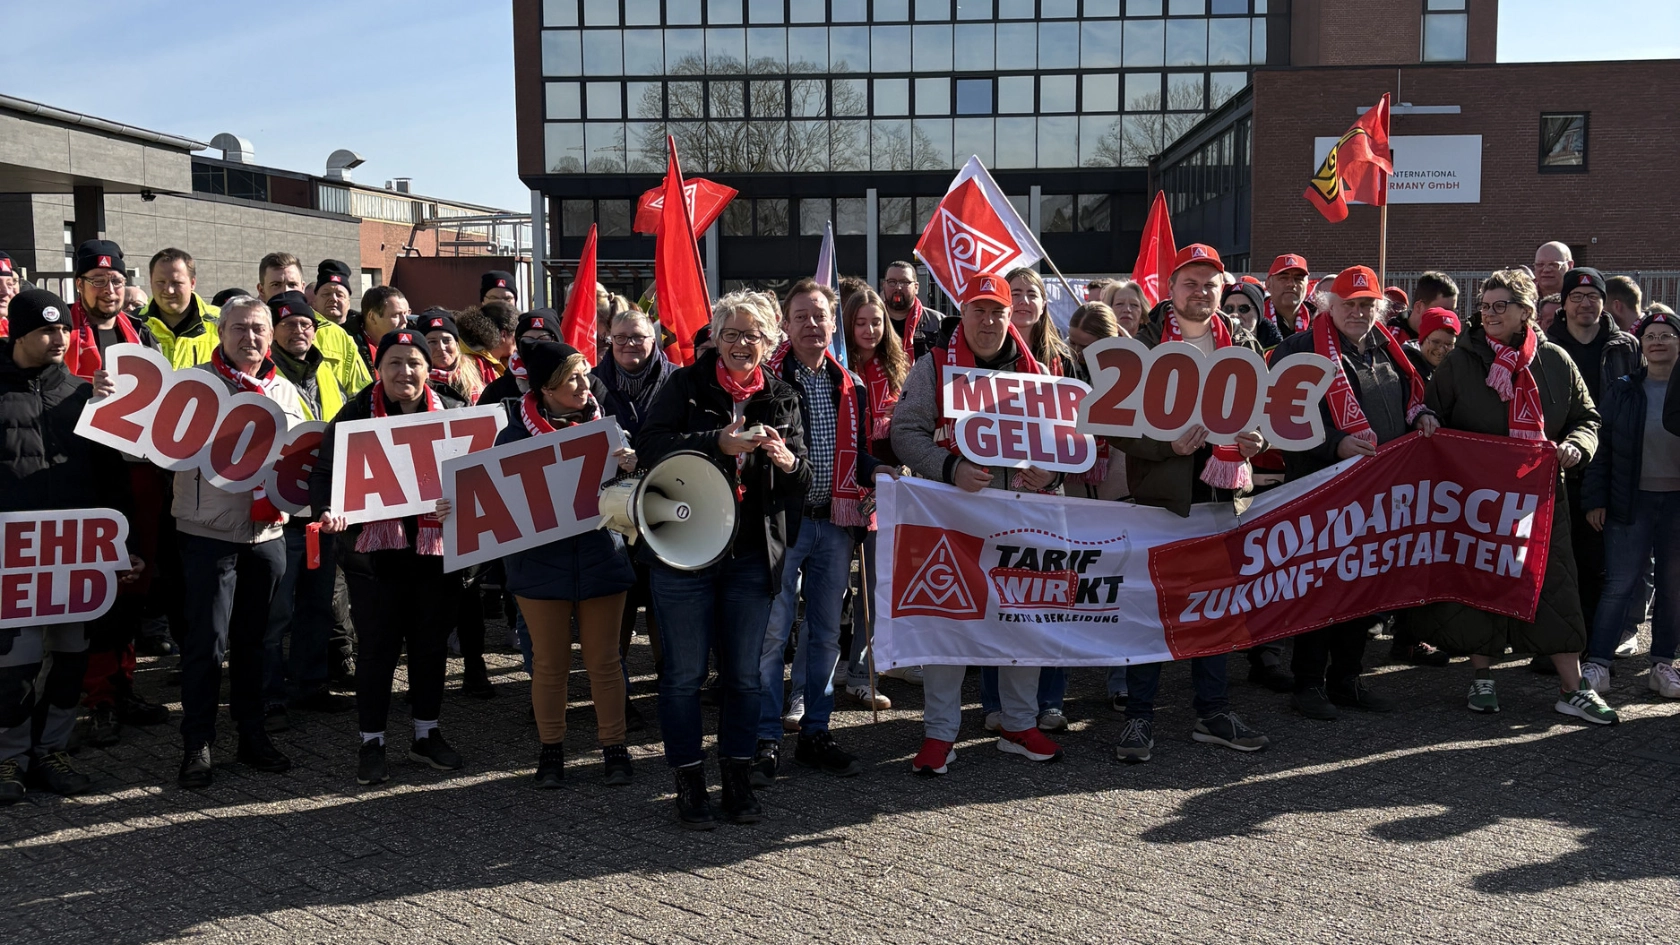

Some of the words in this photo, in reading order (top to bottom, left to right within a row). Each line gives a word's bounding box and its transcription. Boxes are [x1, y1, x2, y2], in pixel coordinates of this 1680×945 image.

[1389, 182, 1426, 190] RMANY
[1428, 181, 1460, 190] GmbH
[1391, 170, 1457, 178] NTERNATIONAL
[952, 373, 1088, 421] MEHR
[1088, 347, 1326, 441] 200€
[964, 416, 1088, 465] GELD
[455, 431, 610, 556] ATZ
[0, 518, 118, 568] EHR
[1238, 479, 1540, 576] SOLIDARISCH
[995, 545, 1102, 574] TARIF
[1179, 556, 1338, 623] ZUKUNFT
[1337, 530, 1529, 582] GESTALTEN
[0, 569, 107, 620] ELD
[998, 612, 1035, 623] TEXTIL
[1035, 614, 1043, 624] &
[1044, 613, 1119, 624] BEKLEIDUNG
